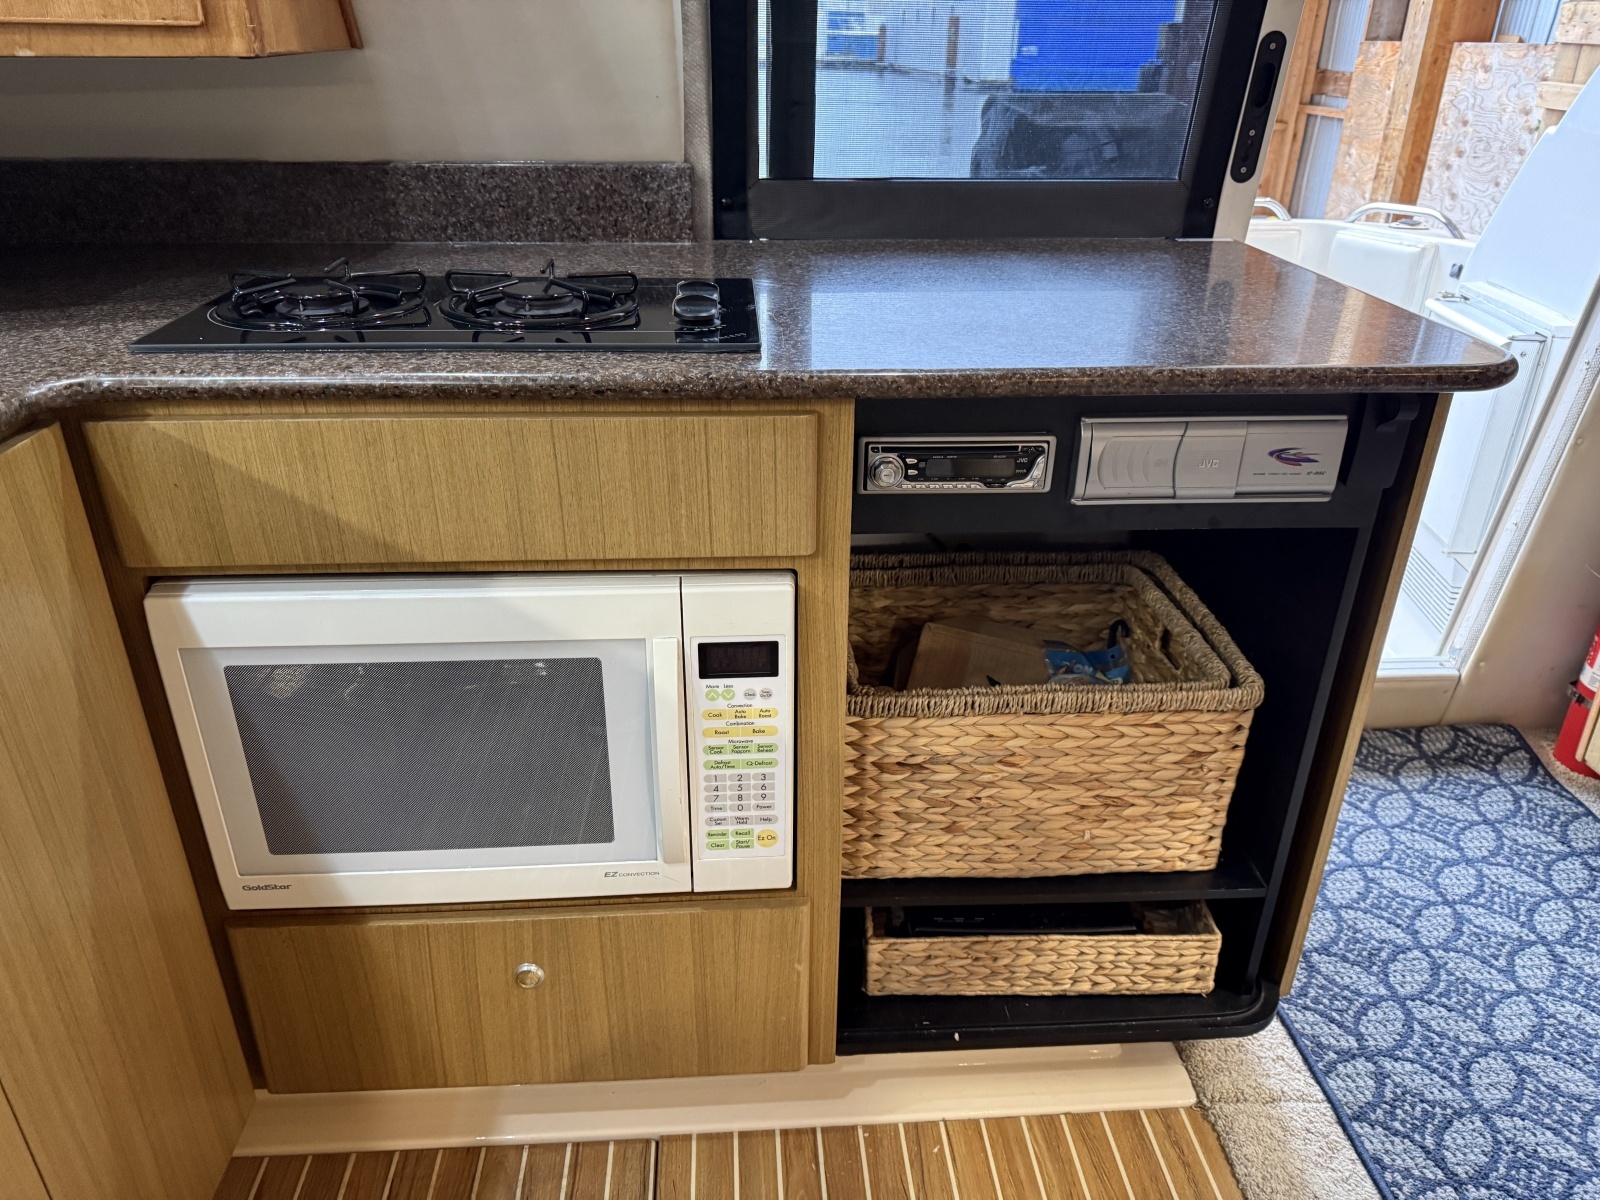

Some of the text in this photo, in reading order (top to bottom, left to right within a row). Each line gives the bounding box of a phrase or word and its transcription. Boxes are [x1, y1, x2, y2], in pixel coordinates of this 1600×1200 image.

[1198, 459, 1219, 468] JVC
[736, 774, 743, 782] 2
[760, 773, 767, 781] 3
[712, 784, 720, 792] 4
[737, 784, 743, 792] 5
[760, 783, 767, 791] 6
[713, 794, 720, 803] 7
[737, 794, 743, 802] 8
[760, 793, 767, 801] 9
[737, 804, 744, 812] 0
